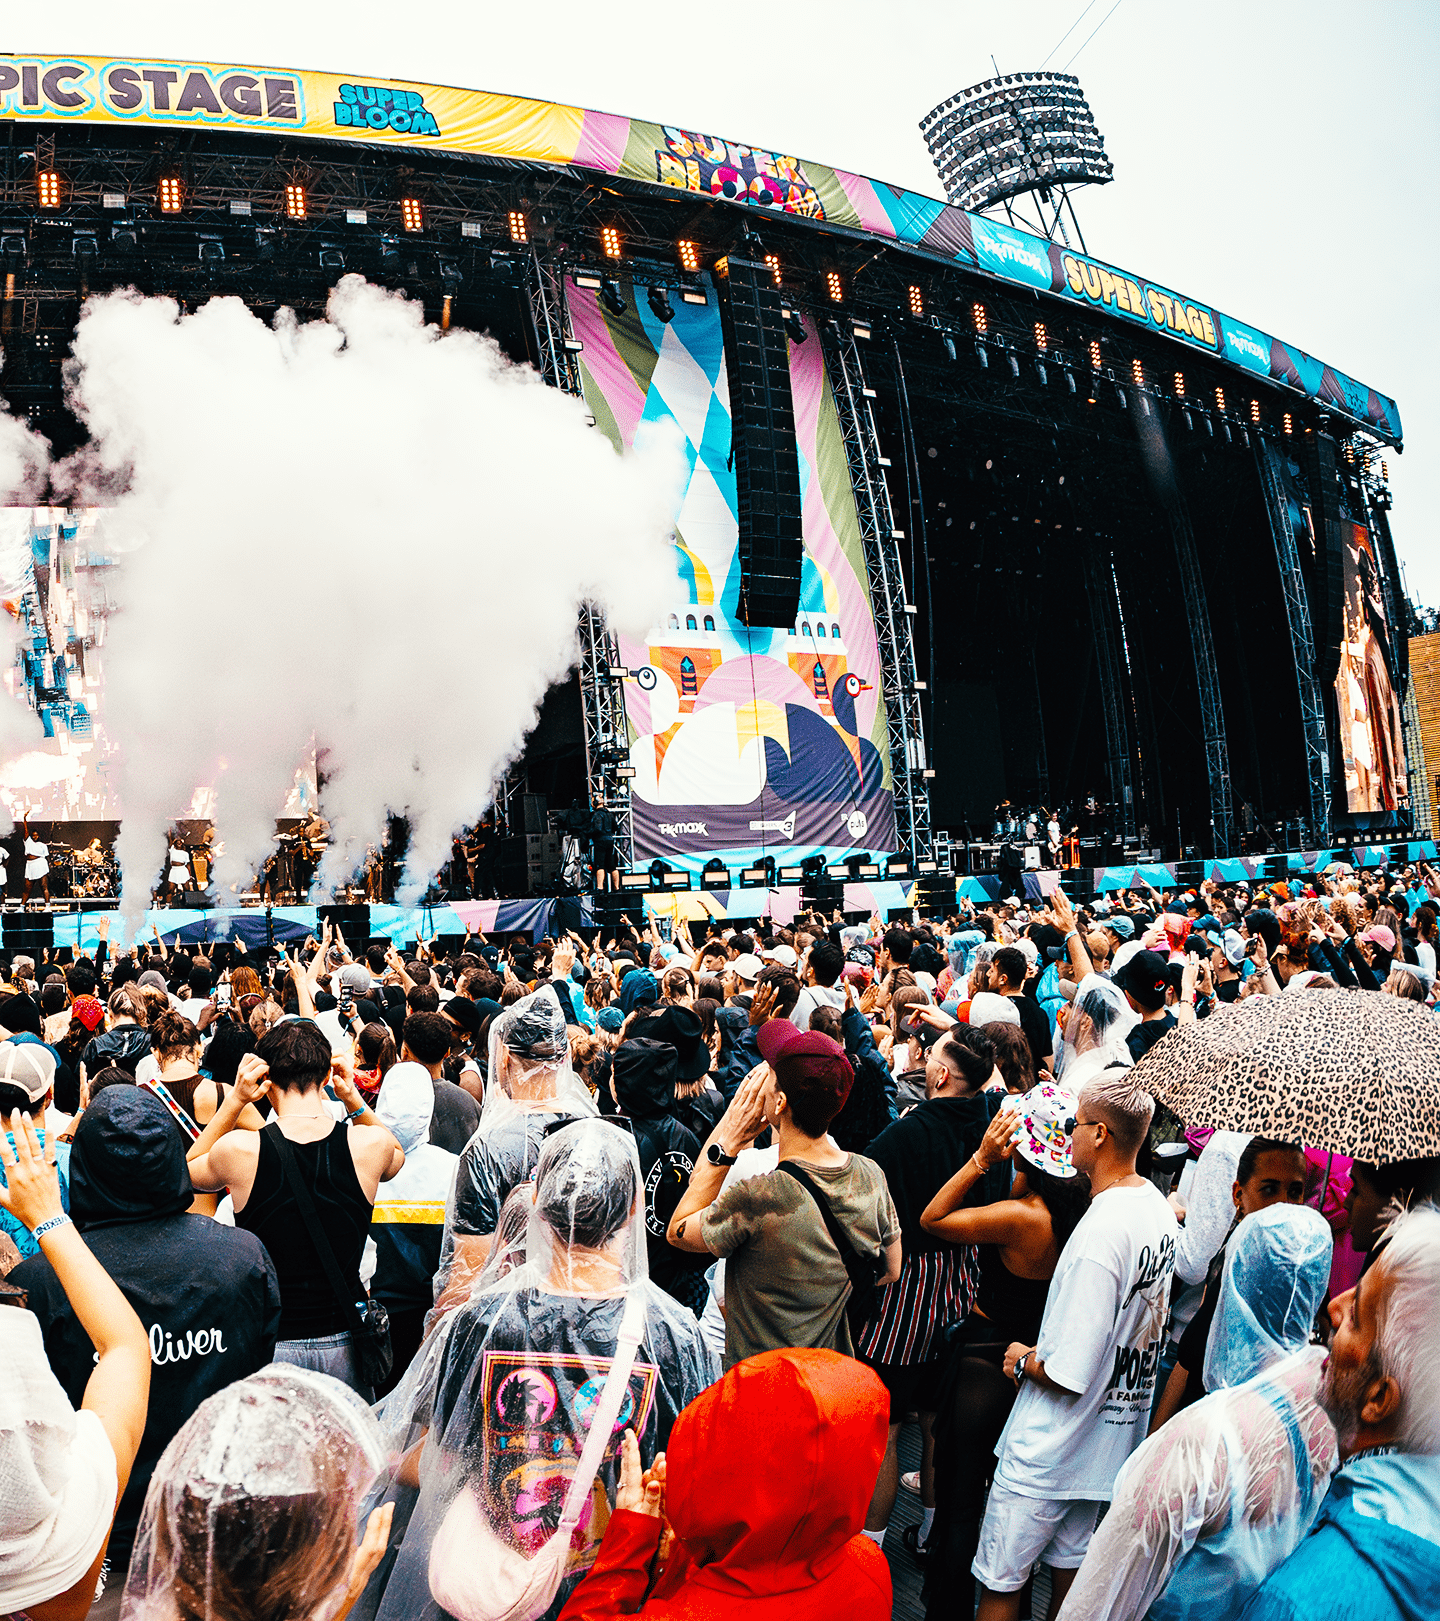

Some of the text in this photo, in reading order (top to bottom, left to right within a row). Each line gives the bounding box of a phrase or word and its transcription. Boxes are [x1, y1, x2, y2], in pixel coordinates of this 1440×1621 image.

[108, 69, 298, 119] STAGE
[334, 103, 441, 137] BLOOM
[337, 84, 426, 112] SUPER
[661, 125, 812, 188] SUPER
[655, 149, 827, 222] BLOOM
[1063, 254, 1216, 352] SUPER STAGE
